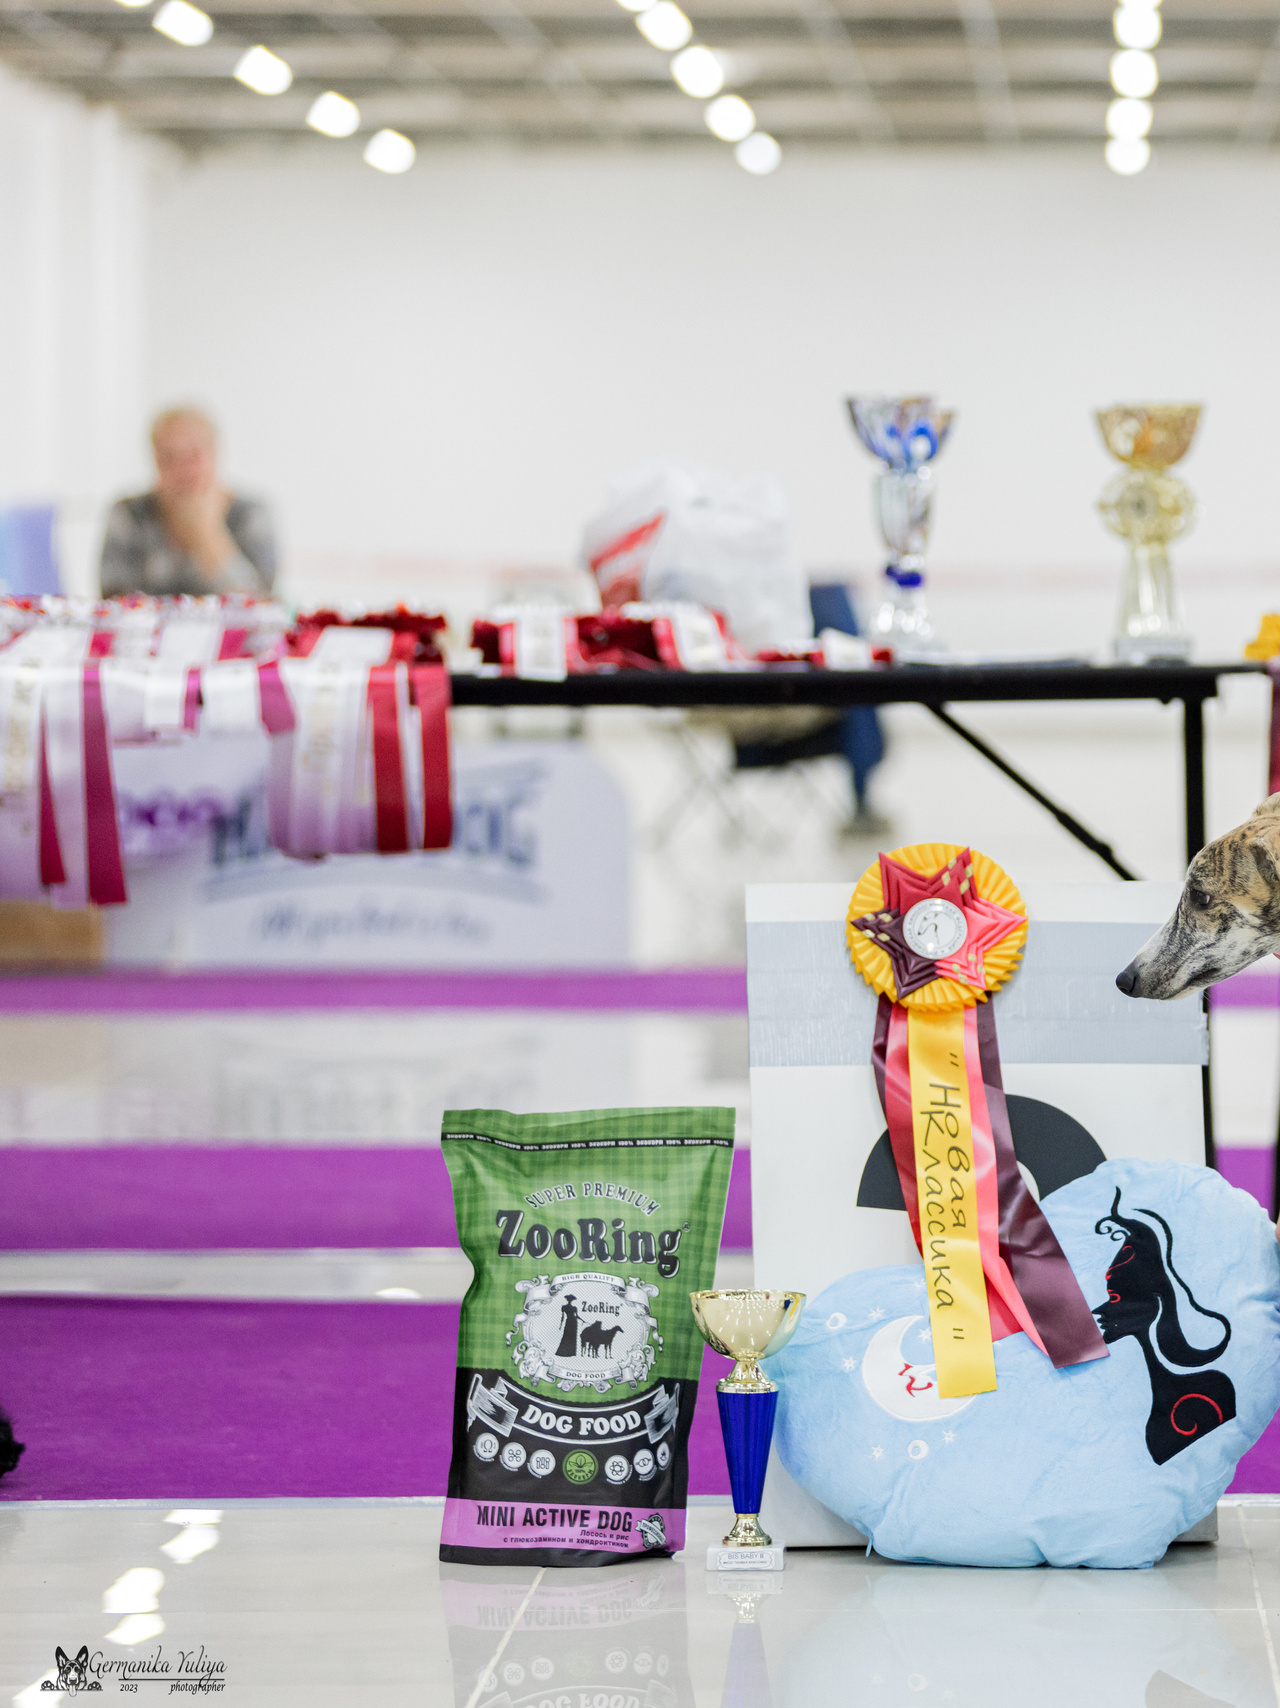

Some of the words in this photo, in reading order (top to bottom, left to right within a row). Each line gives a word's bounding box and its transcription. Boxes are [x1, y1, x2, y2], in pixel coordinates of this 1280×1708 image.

[524, 1183, 577, 1209] SUPER
[582, 1181, 661, 1217] PREMIUM
[919, 1110, 955, 1310] Классика
[583, 1273, 615, 1282] QUALITY
[581, 1301, 620, 1317] ZooRing
[566, 1371, 583, 1379] DOG
[585, 1371, 606, 1379] FOOD
[521, 1404, 573, 1434] DOG
[578, 1410, 642, 1436] FOOD
[476, 1505, 516, 1527] MINI
[522, 1507, 591, 1528] ACTIVE
[597, 1510, 633, 1532] DOG
[580, 1529, 607, 1539] Лосось
[576, 1537, 629, 1548] хондроитином
